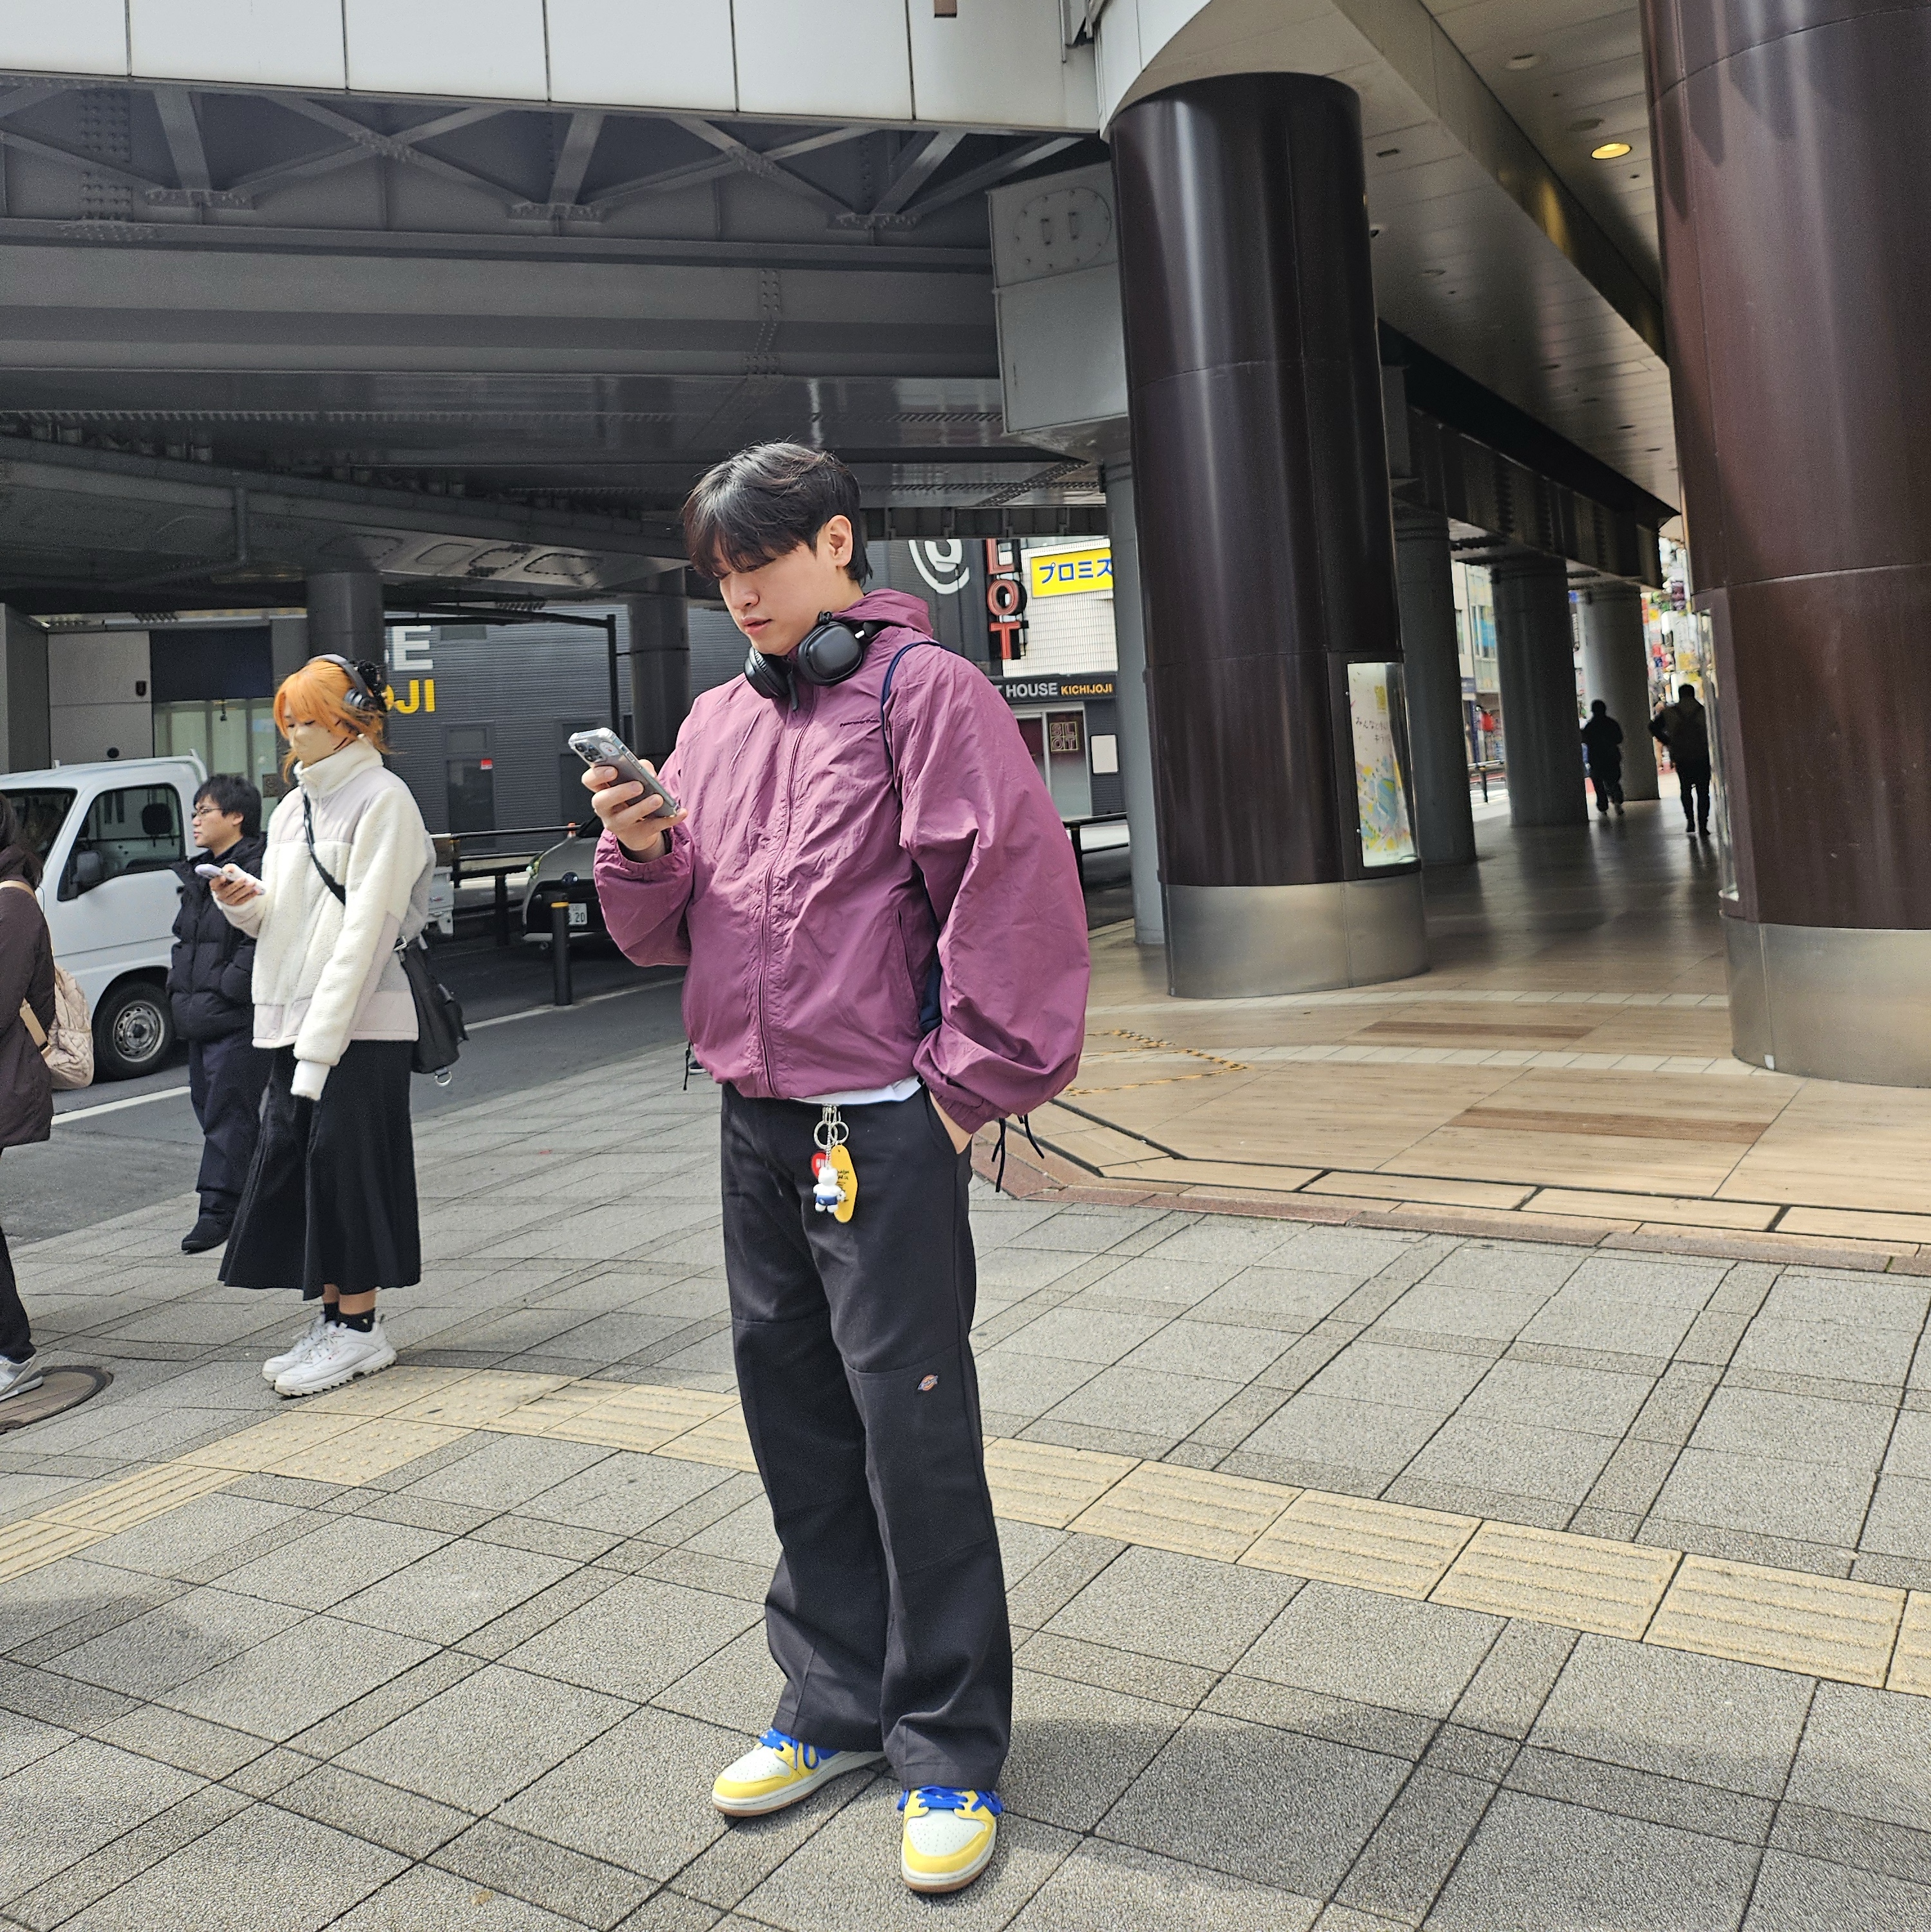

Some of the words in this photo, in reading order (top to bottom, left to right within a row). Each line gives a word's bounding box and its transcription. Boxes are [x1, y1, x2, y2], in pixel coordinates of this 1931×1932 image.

[1039, 558, 1113, 583] プロミス
[384, 625, 433, 670] E
[382, 679, 435, 714] JI
[1006, 683, 1058, 697] HOUSE
[1061, 683, 1113, 695] KICHIJOJI
